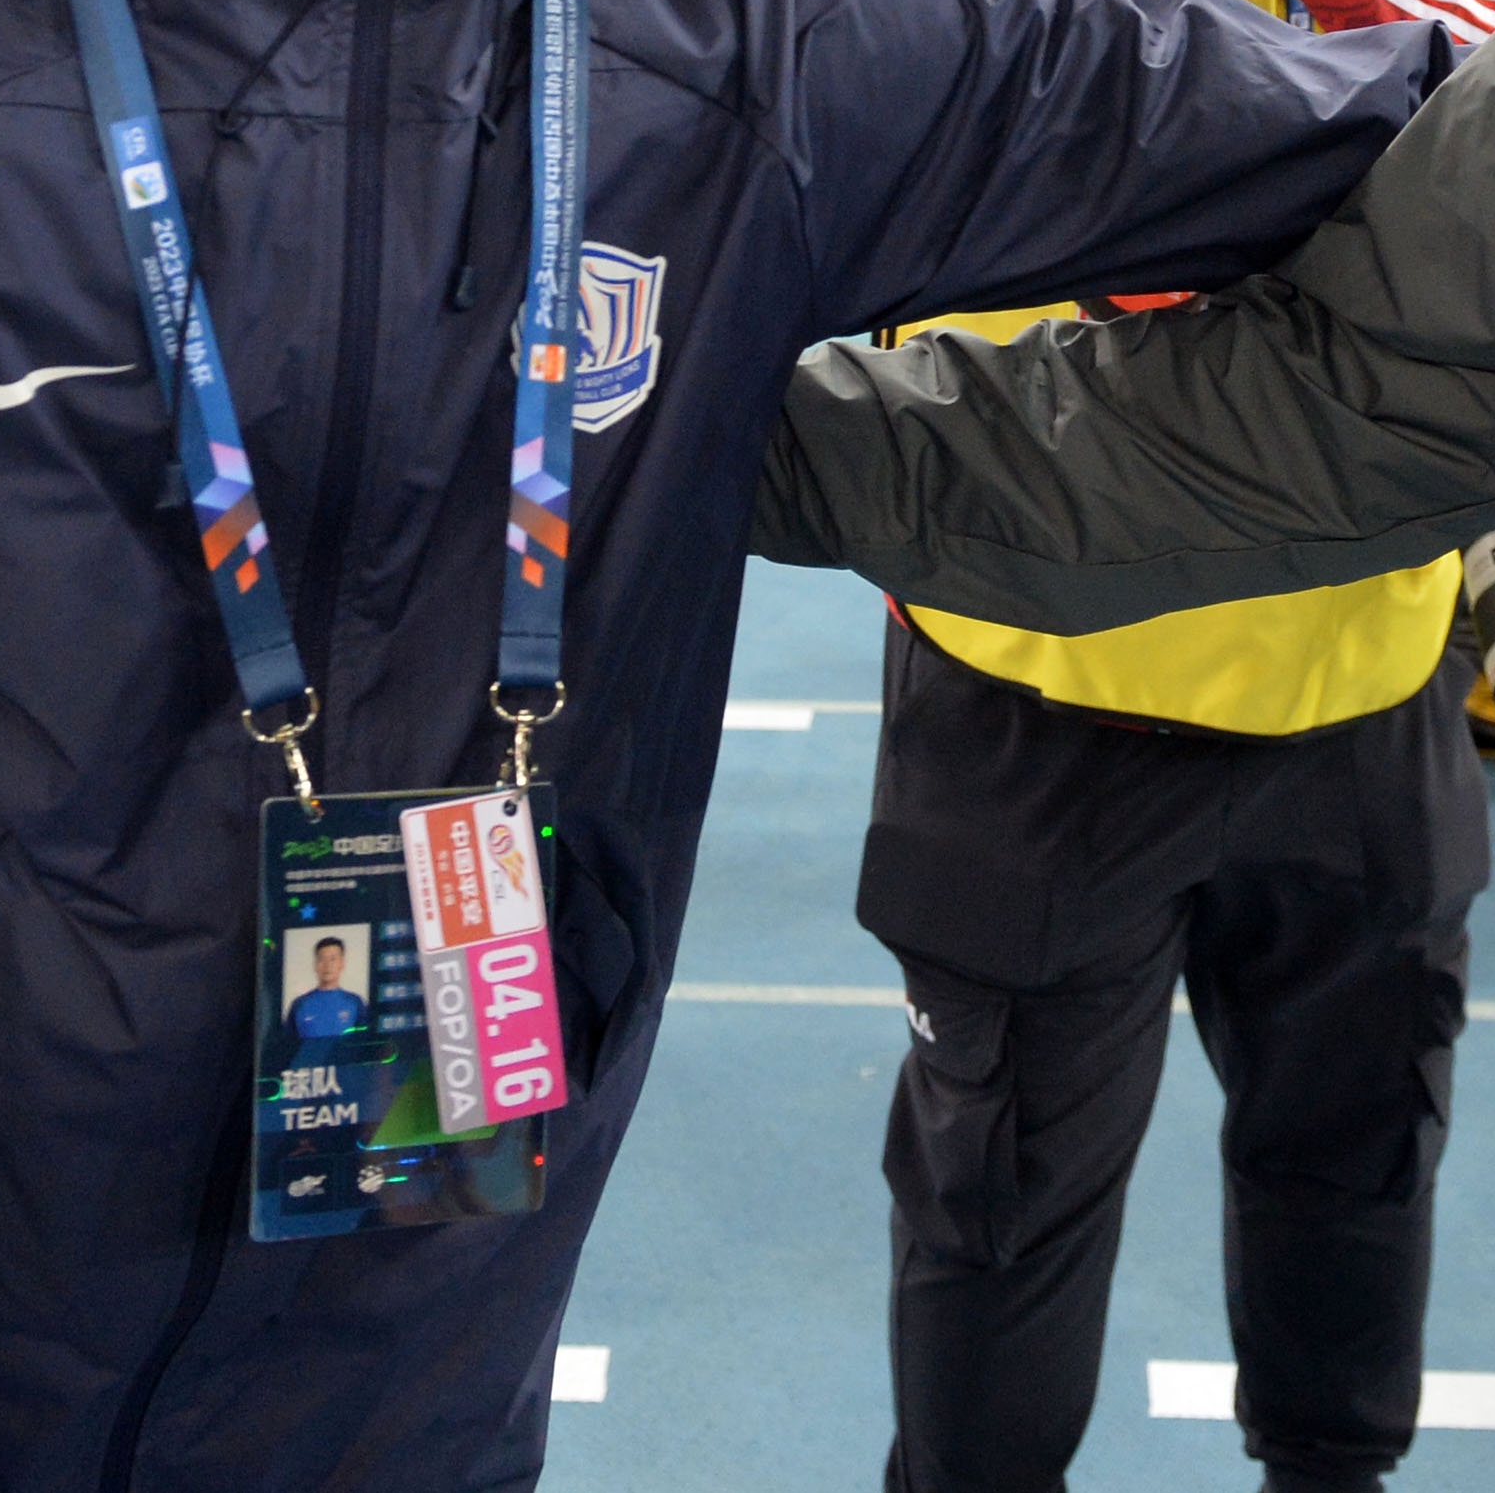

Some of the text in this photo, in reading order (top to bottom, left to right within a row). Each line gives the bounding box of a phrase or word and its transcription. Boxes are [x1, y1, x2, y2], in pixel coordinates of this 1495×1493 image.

[448, 819, 485, 926] 中国平安
[431, 961, 480, 1118] FOP/OA
[478, 944, 554, 1107] 04.16
[280, 1103, 358, 1130] TEAM
